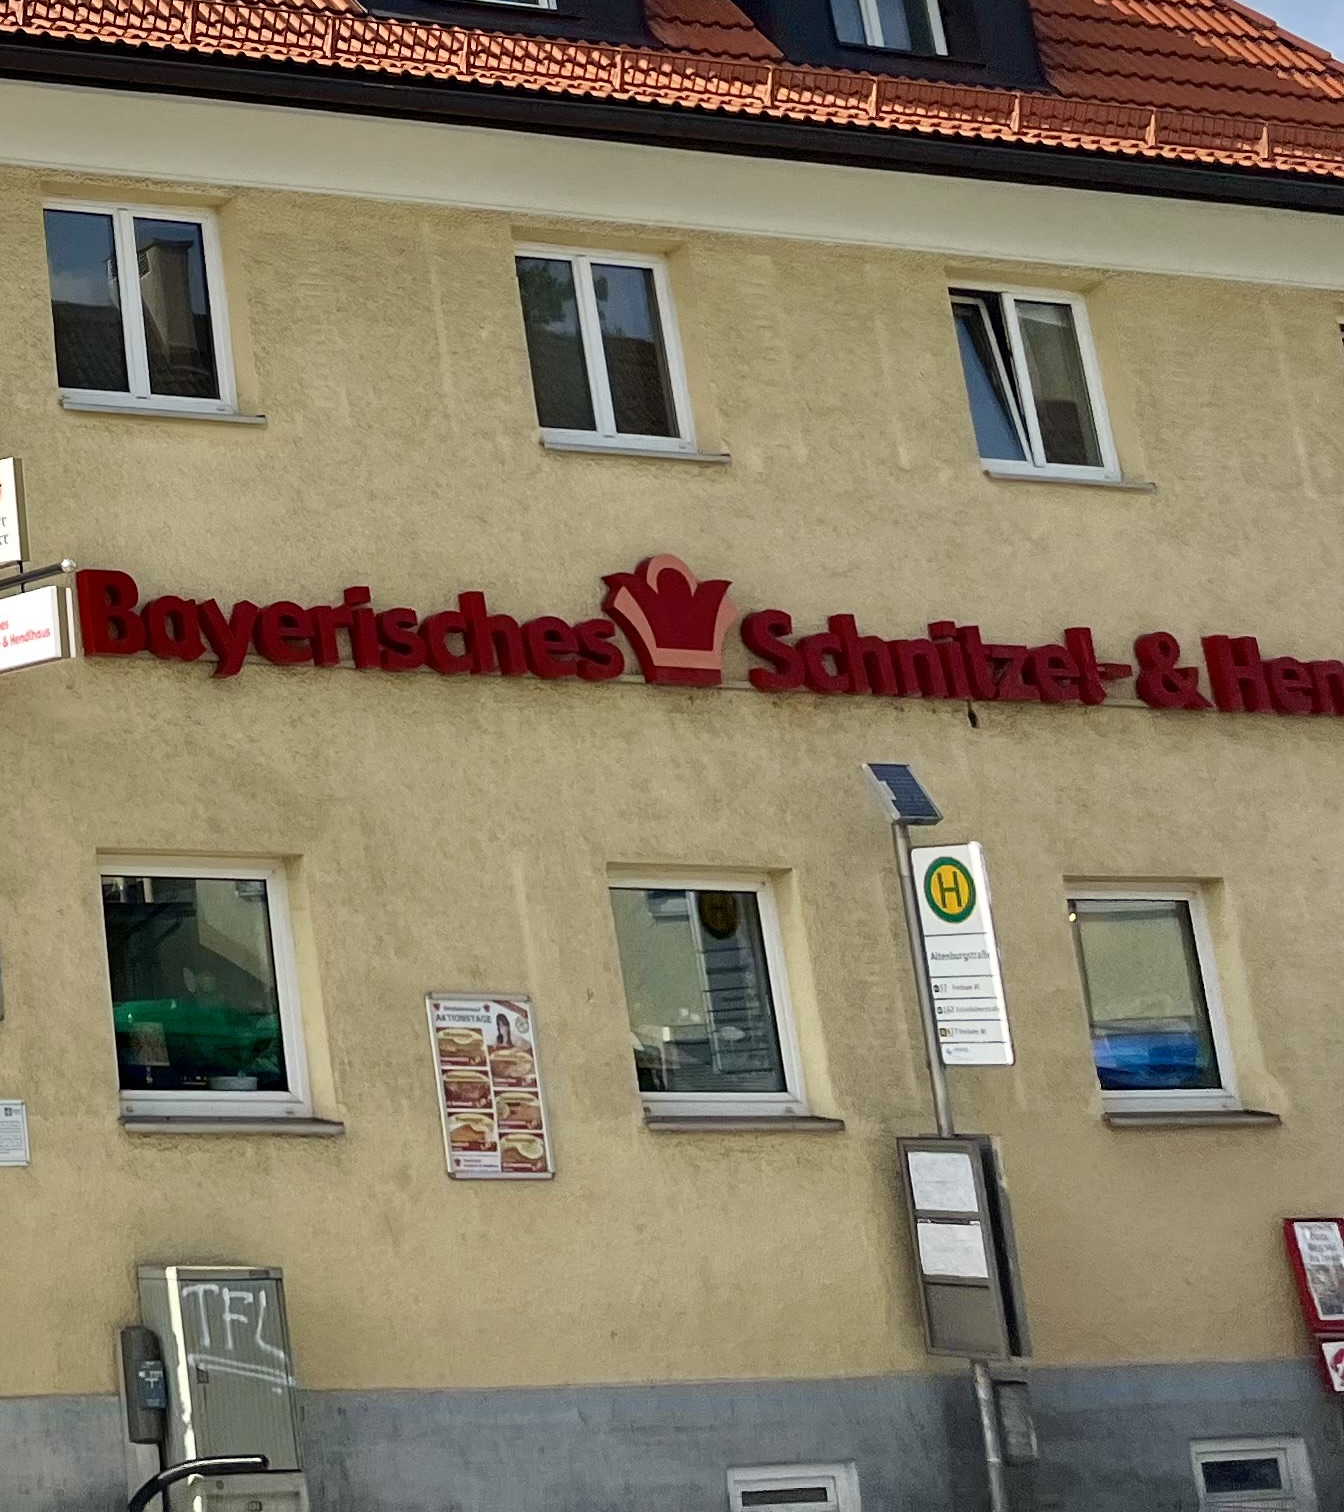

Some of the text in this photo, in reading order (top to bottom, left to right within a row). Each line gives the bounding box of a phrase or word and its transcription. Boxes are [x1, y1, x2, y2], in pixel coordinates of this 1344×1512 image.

[10, 628, 51, 646] Hendlhaus
[77, 569, 624, 680] Bayerisches
[741, 609, 1132, 705] Schnitzel-
[1134, 631, 1212, 709] &
[937, 870, 963, 909] H
[183, 1284, 285, 1361] TFL
